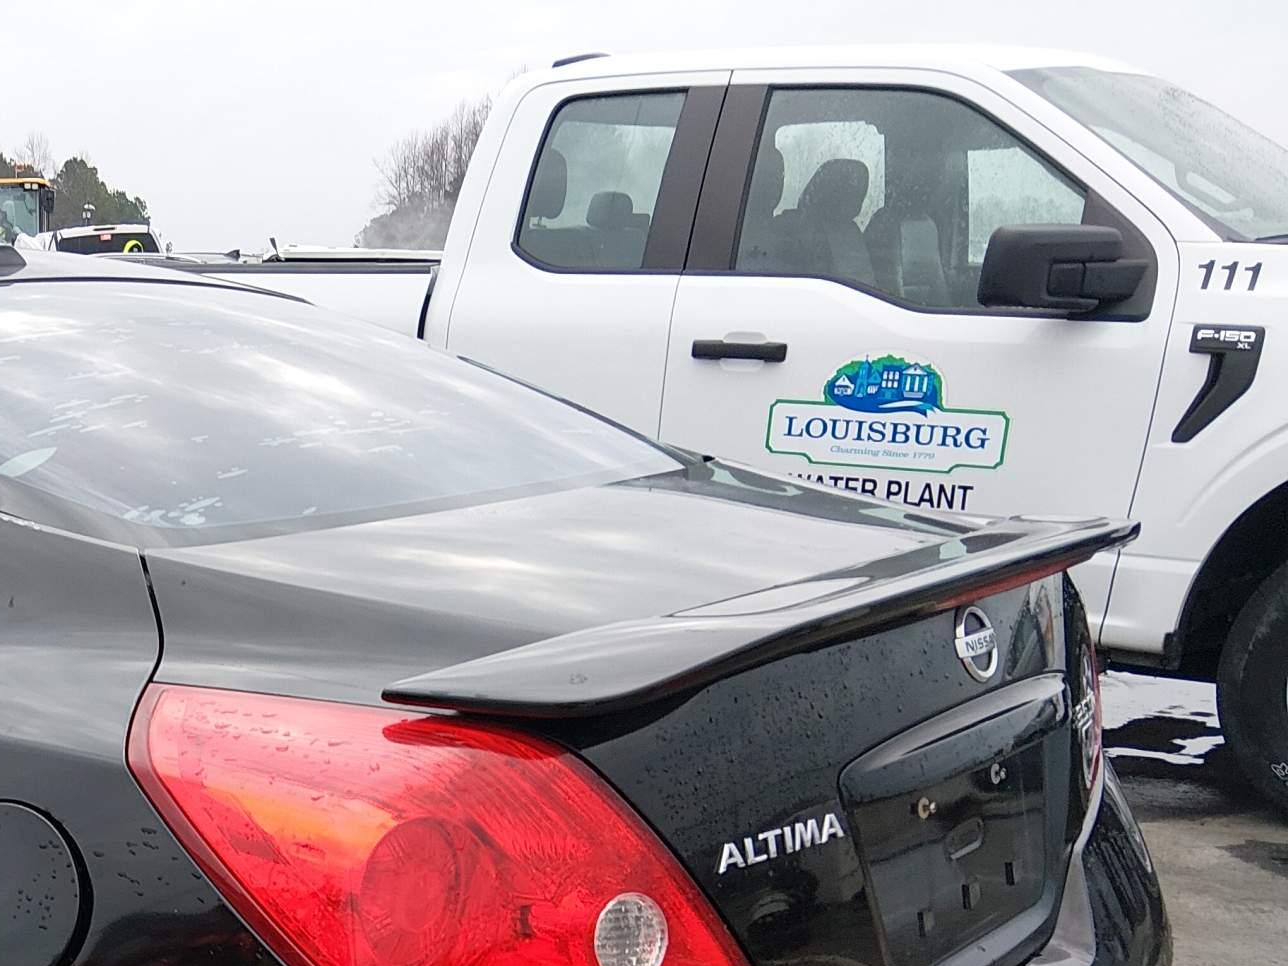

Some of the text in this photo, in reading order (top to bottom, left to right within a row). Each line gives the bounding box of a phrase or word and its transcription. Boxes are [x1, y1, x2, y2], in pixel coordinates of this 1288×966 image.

[1198, 259, 1263, 291] 111
[1196, 329, 1256, 343] F-150
[783, 415, 990, 450] LOUISBURG
[830, 445, 880, 457] Charming
[881, 449, 910, 458] Since
[885, 480, 974, 511] PLANT
[718, 813, 845, 874] ALTIMA
